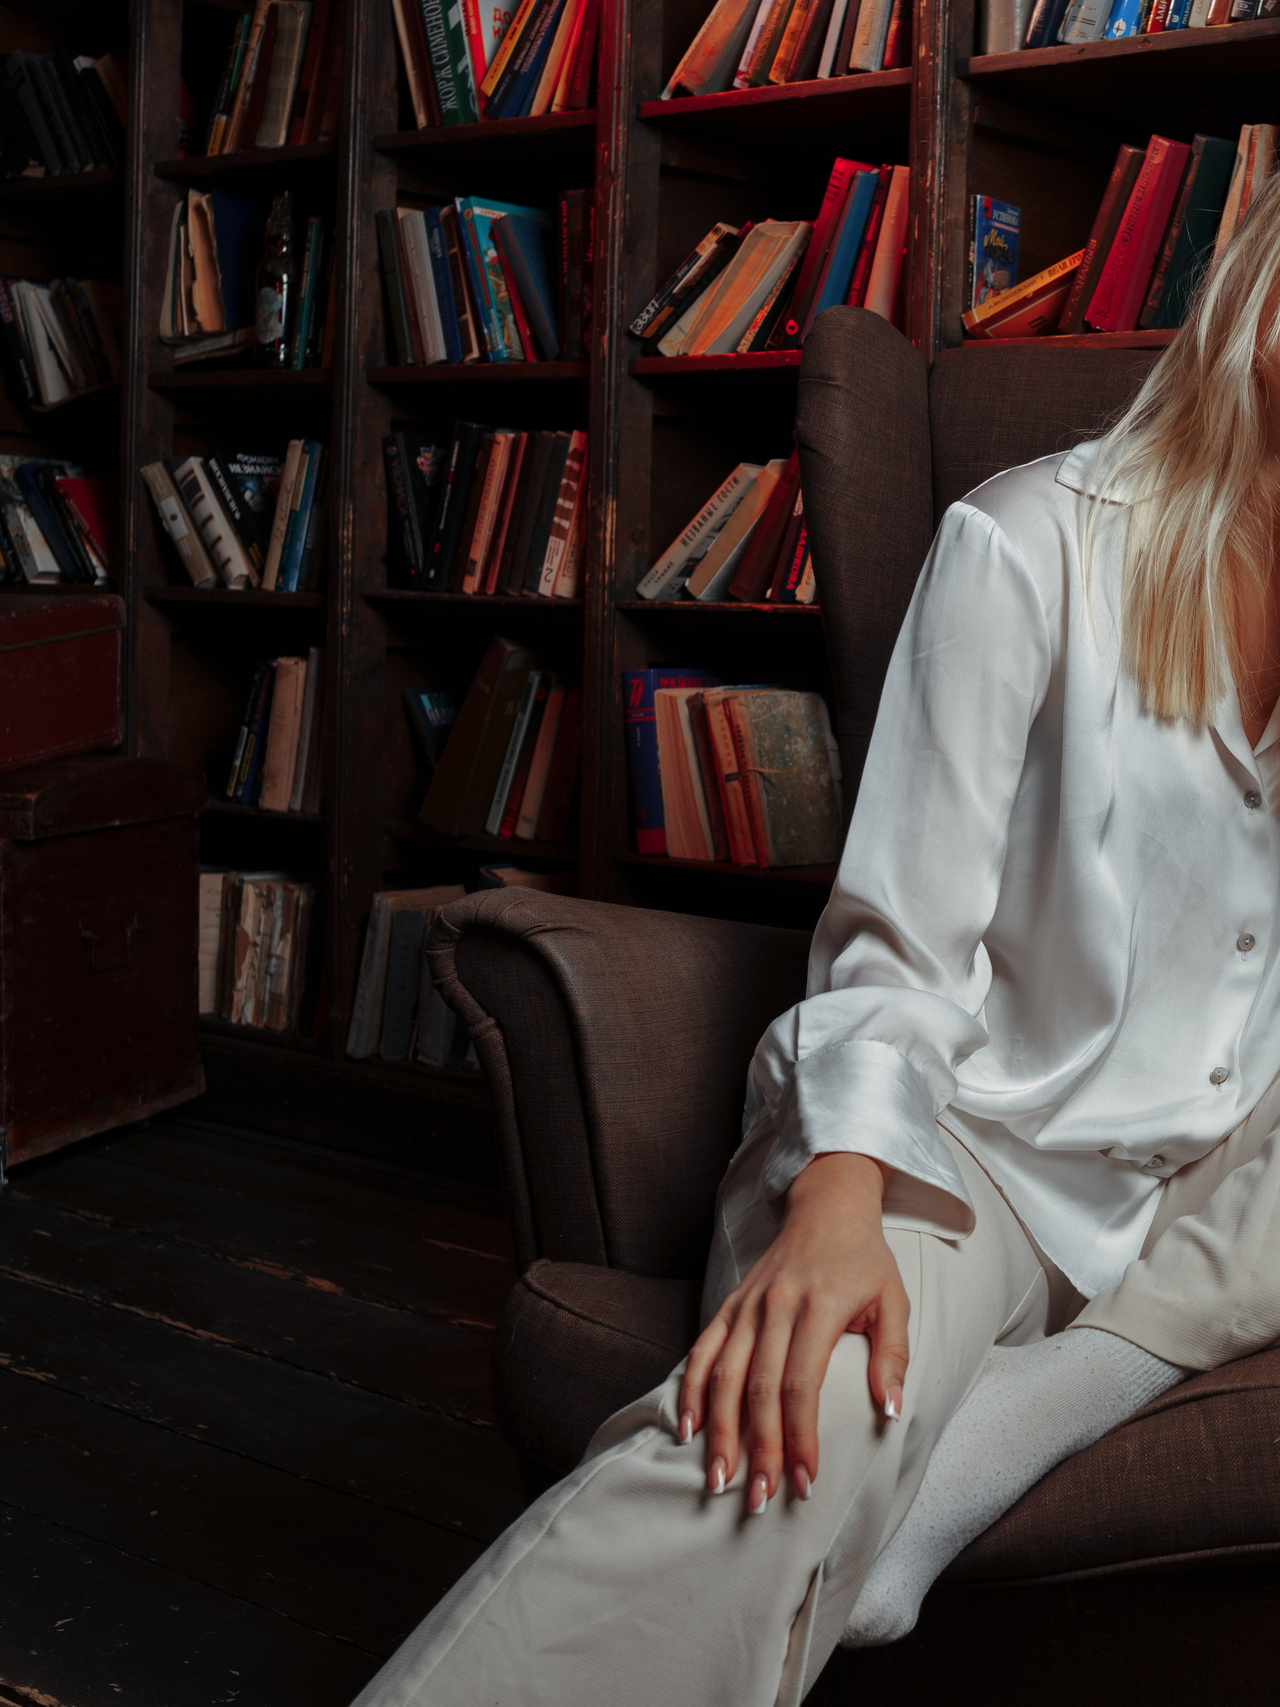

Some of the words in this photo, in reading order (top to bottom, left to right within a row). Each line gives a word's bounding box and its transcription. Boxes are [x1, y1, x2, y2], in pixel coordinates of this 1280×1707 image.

[435, 65, 458, 112] ЖОРЖ
[680, 502, 719, 548] НЕЗВАНЫЕ
[717, 475, 740, 503] ГОСТИ
